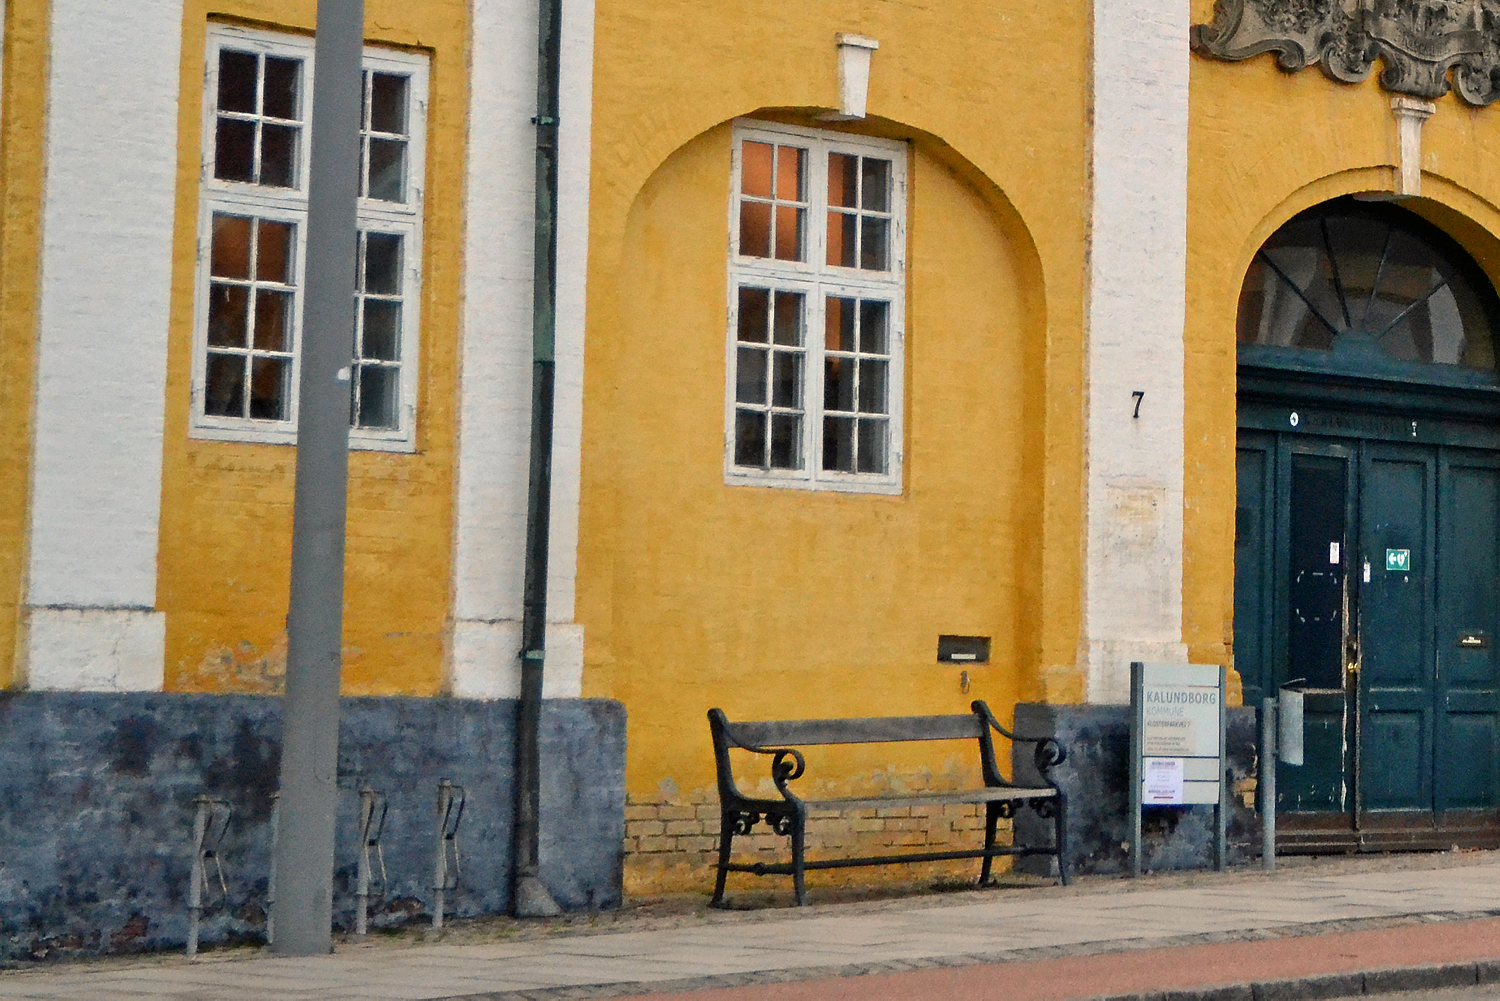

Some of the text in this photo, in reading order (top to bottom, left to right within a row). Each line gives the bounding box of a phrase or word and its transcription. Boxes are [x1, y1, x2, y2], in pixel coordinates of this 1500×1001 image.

[1131, 390, 1145, 419] 7
[1146, 691, 1216, 705] KALUNDBORG
[1146, 706, 1185, 717] KOMMUNE
